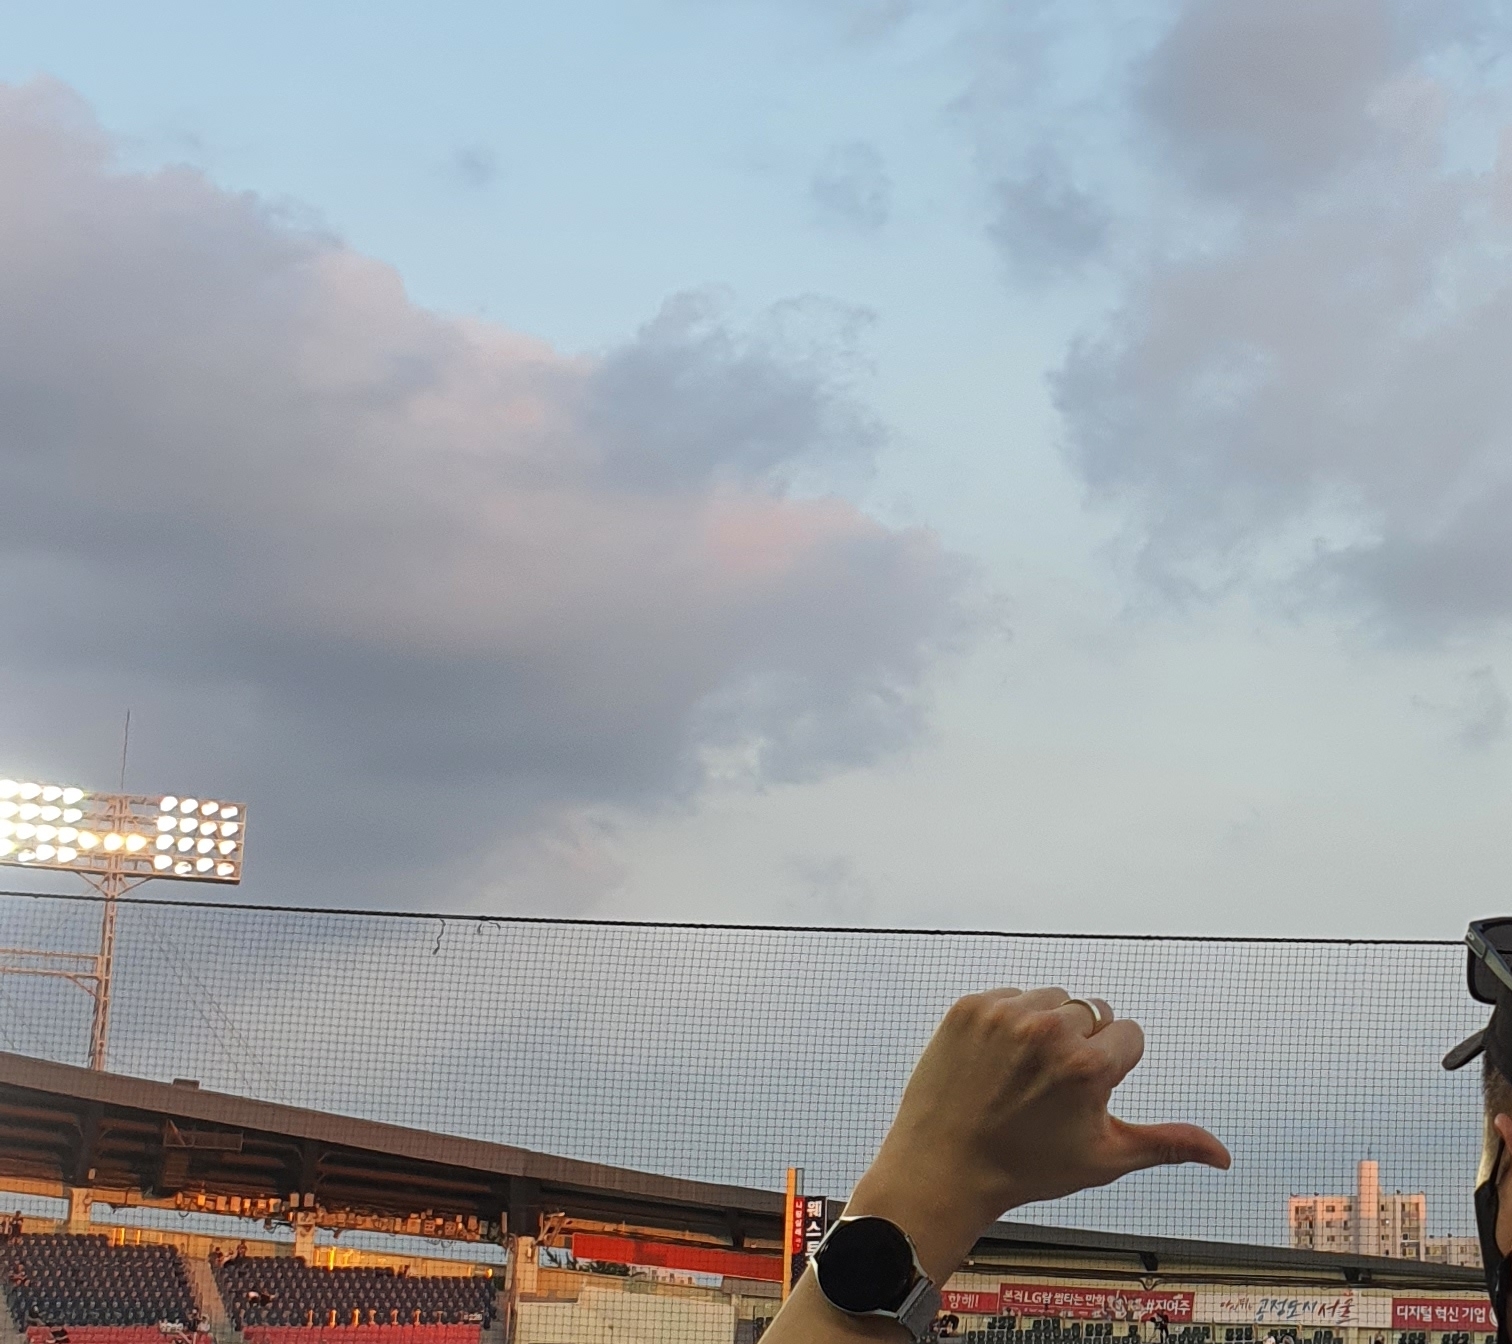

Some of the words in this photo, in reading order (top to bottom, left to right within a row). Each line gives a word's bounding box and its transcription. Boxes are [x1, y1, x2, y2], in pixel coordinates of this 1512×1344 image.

[1318, 1298, 1357, 1323] 서울
[1397, 1305, 1432, 1322] 디지털
[1435, 1307, 1459, 1323] 혁신
[1462, 1308, 1486, 1324] 기업
